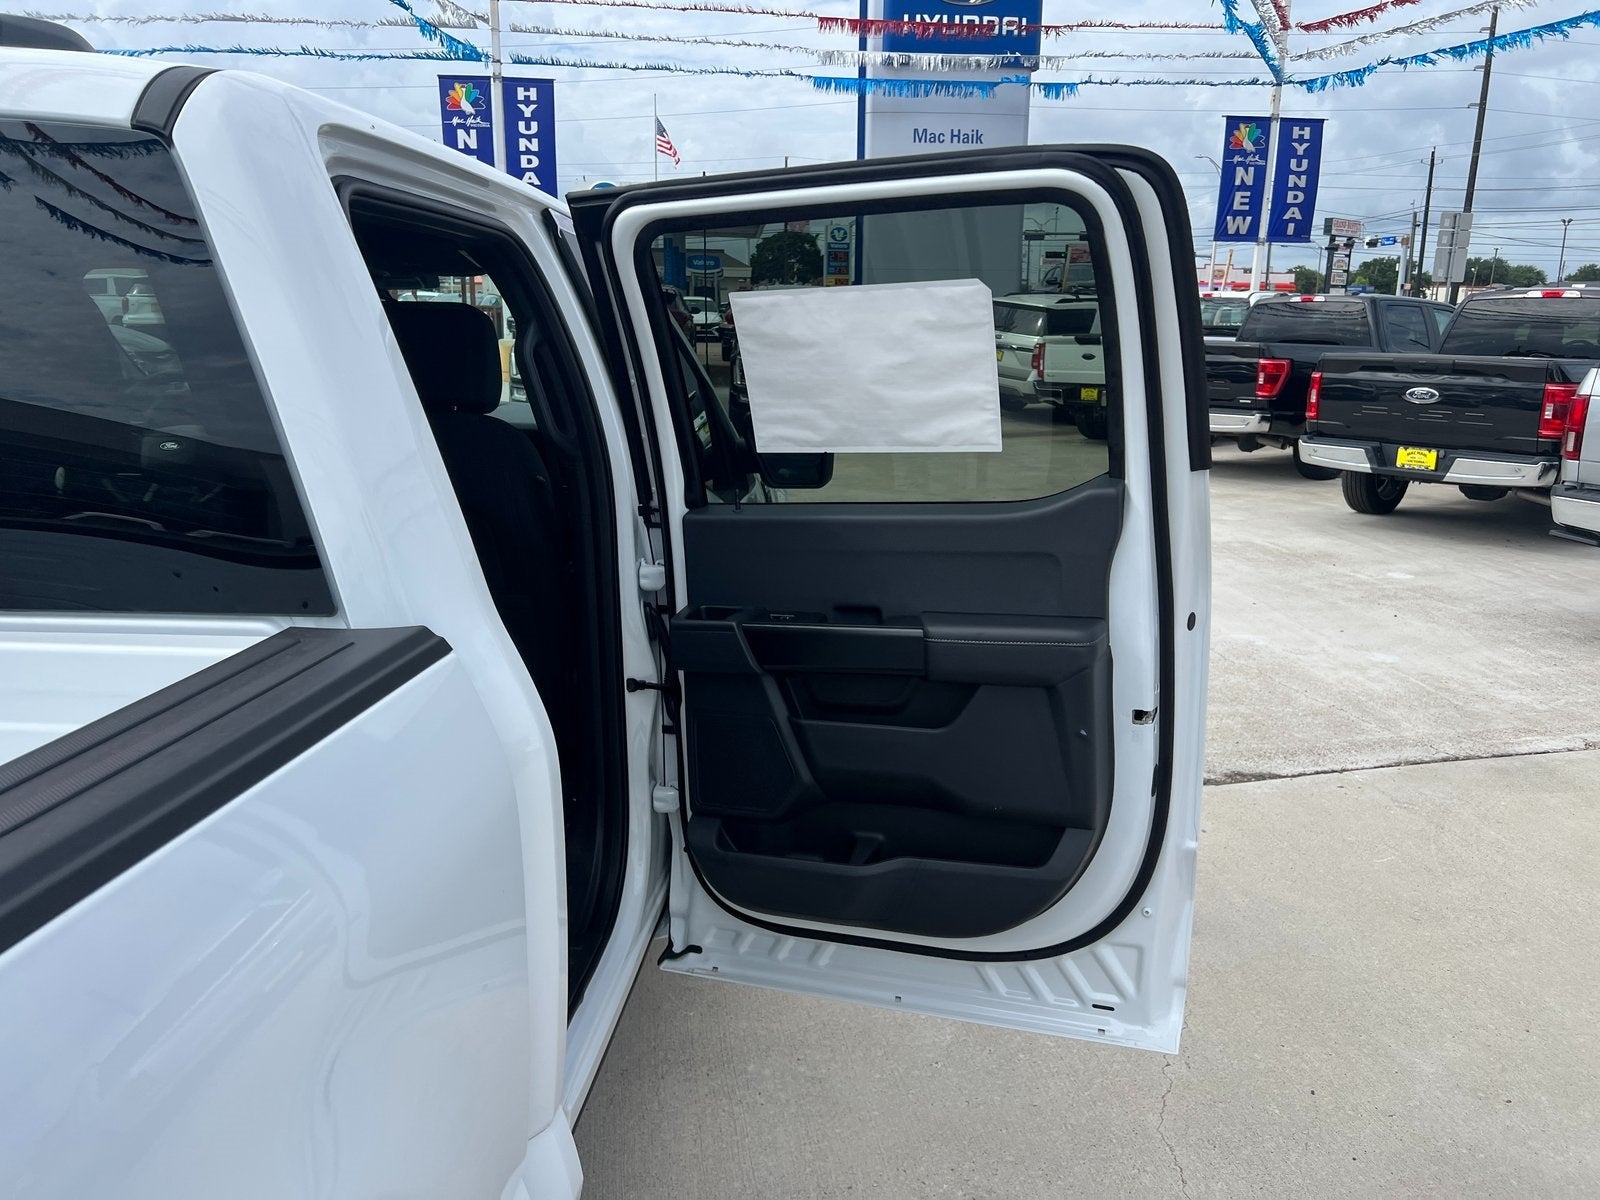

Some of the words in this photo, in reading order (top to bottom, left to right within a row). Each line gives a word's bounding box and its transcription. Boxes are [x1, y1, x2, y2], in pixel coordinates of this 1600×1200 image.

[913, 128, 945, 144] Mac
[950, 128, 983, 145] Haik
[1226, 166, 1255, 235] NEW
[1282, 126, 1311, 235] HYUNDAI
